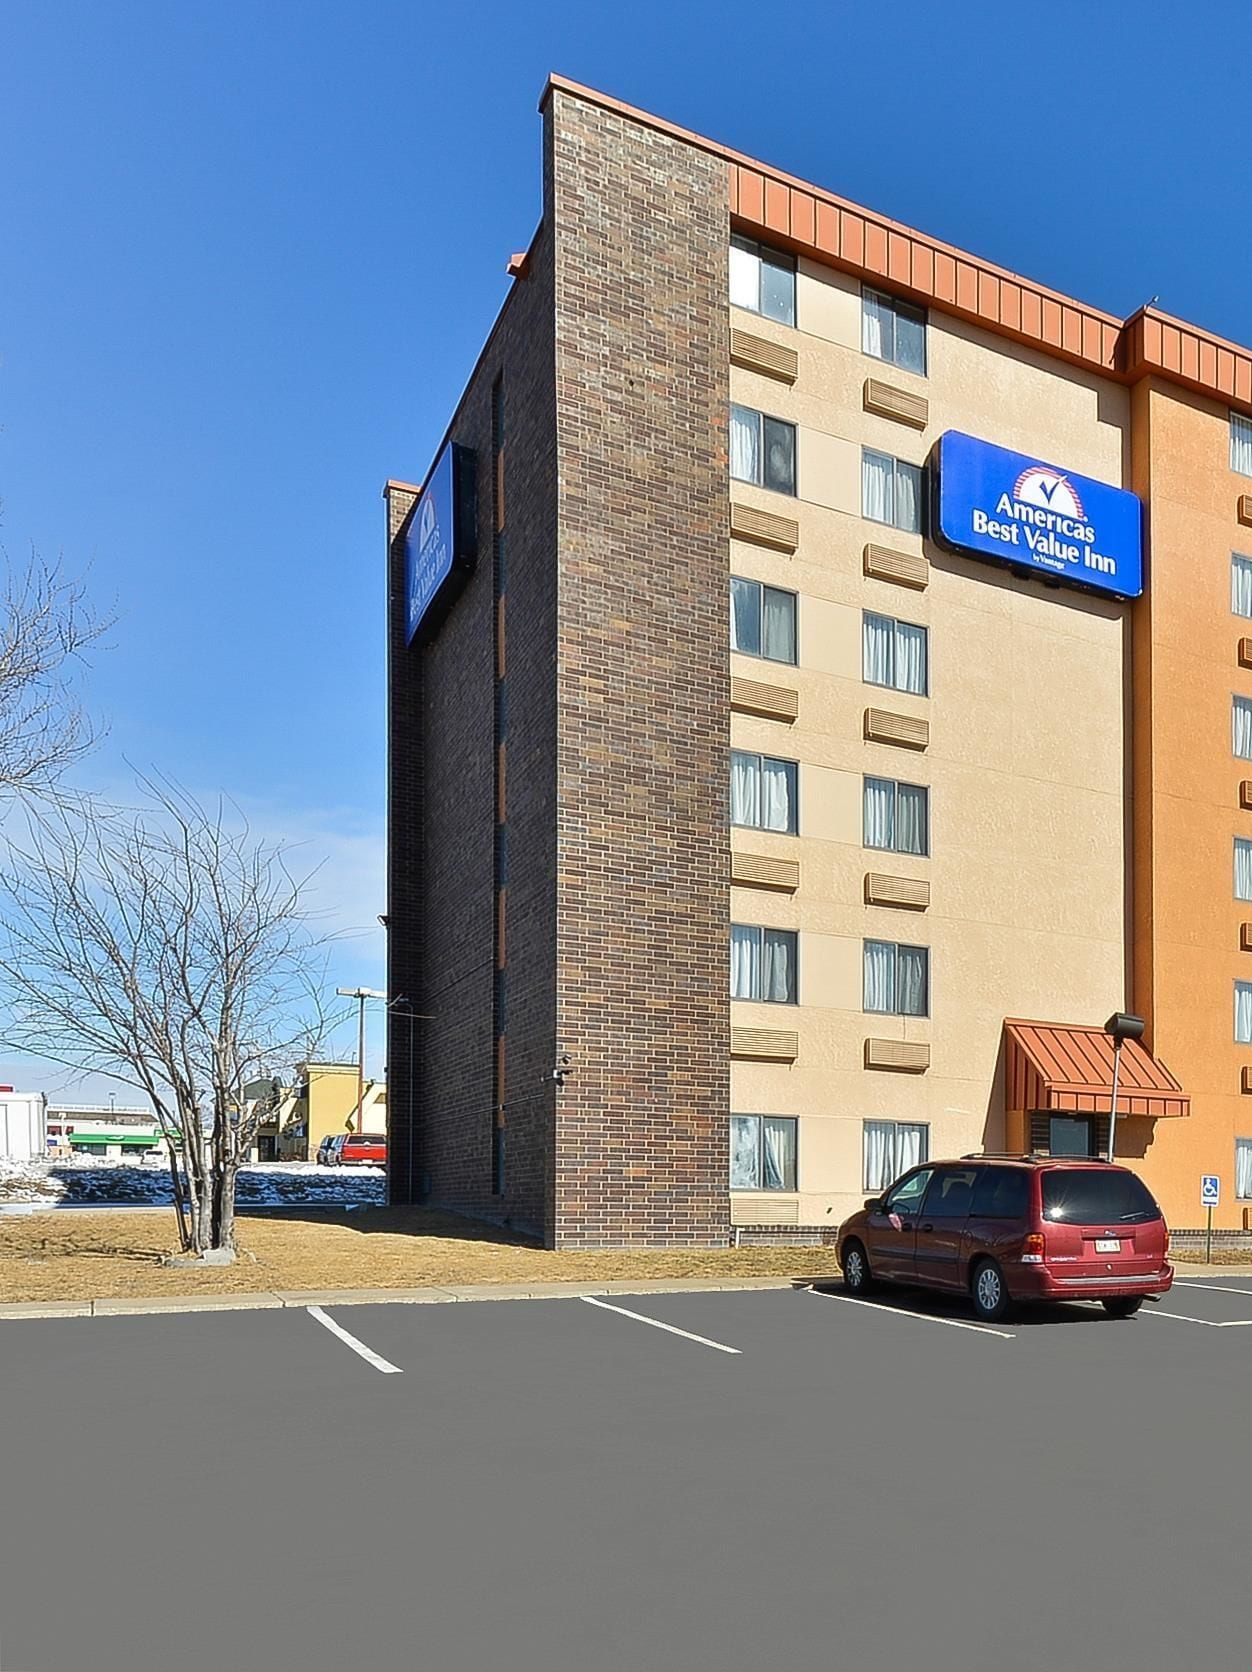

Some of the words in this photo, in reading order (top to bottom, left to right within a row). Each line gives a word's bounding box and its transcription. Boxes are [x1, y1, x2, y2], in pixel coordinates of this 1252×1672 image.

[973, 510, 1019, 545] Best
[1024, 526, 1079, 564] Value
[1085, 545, 1116, 576] Inn
[996, 493, 1095, 544] Americas
[1033, 553, 1039, 562] by
